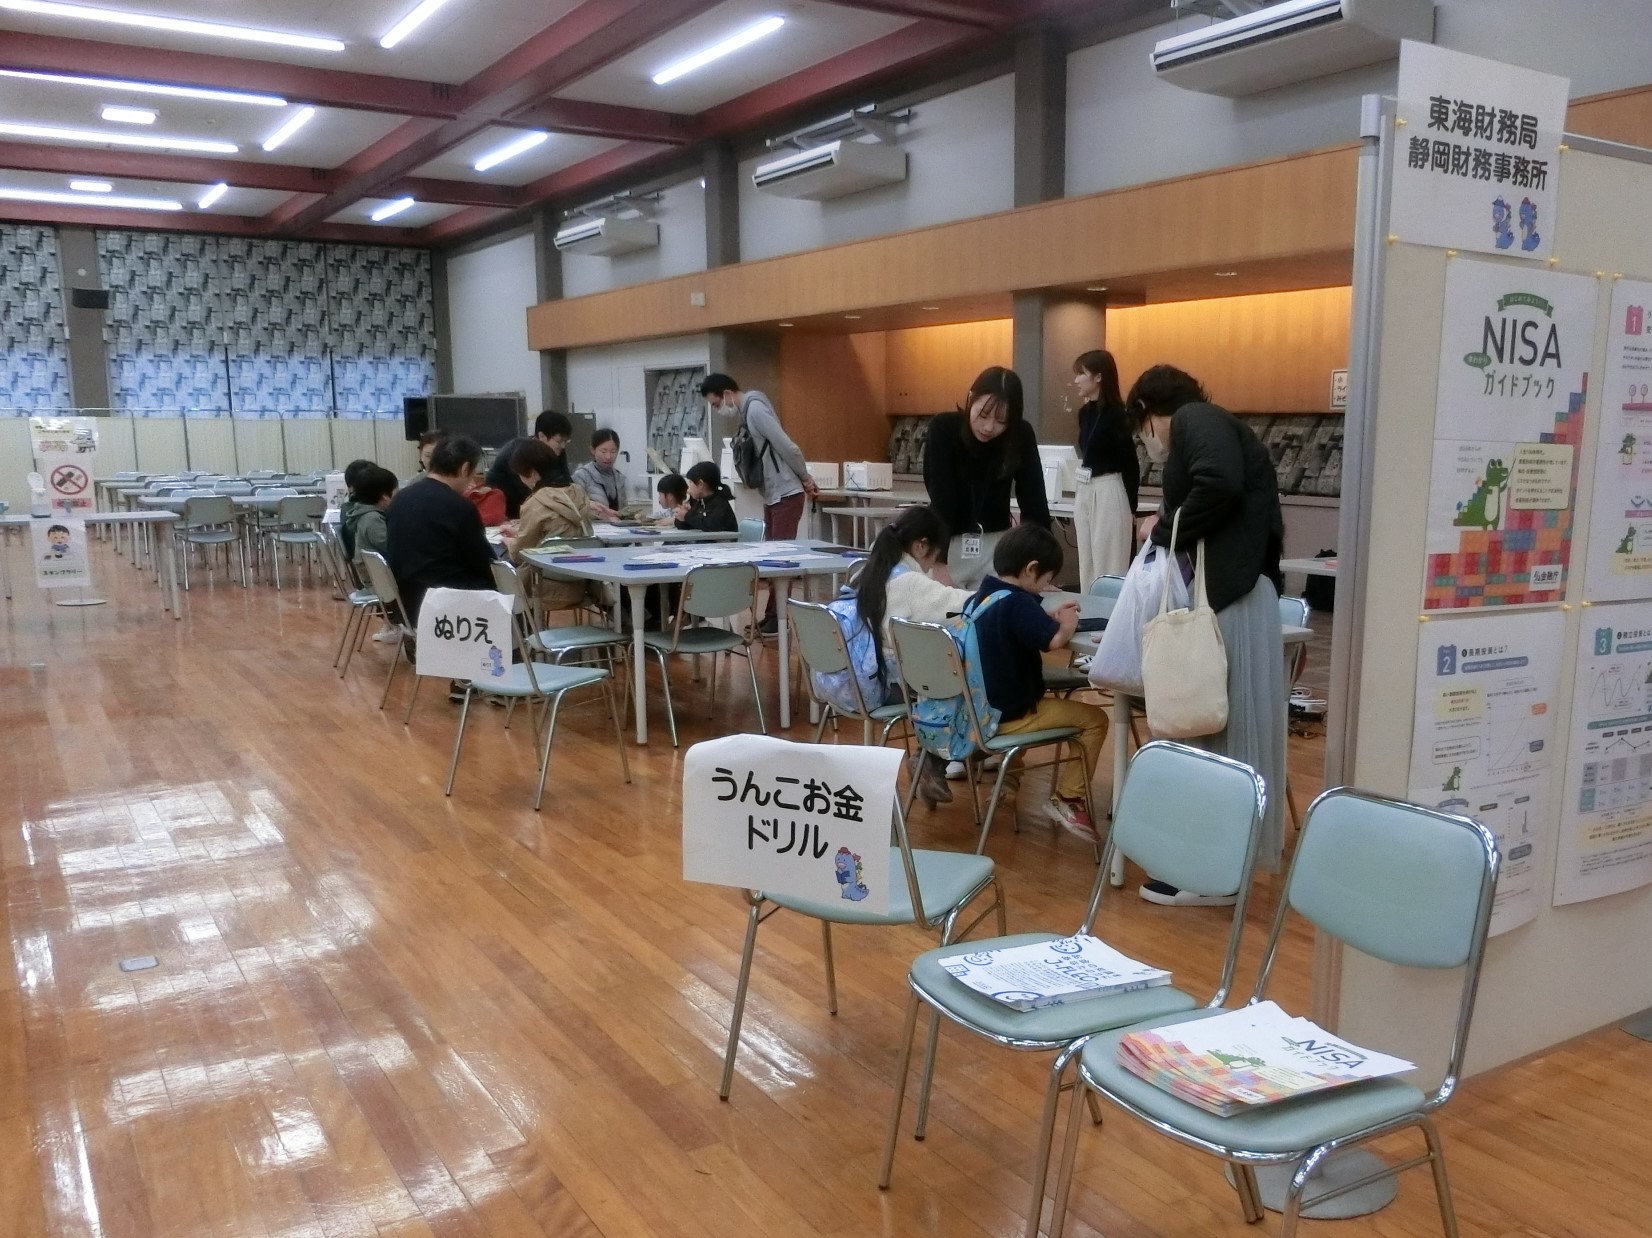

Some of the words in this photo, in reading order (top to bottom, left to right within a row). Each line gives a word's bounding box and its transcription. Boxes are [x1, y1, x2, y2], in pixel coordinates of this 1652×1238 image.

[1427, 94, 1539, 150] 東海財務局
[1408, 135, 1548, 191] 静岡財務事務所
[1482, 315, 1562, 369] NISA
[1483, 370, 1555, 399] ガイドブック
[434, 614, 493, 644] ぬりえ
[1599, 637, 1607, 654] 3
[1442, 655, 1451, 673] 2
[711, 766, 864, 823] うんこお金
[747, 814, 829, 859] ドリル
[1043, 959, 1099, 982] J-FLEC
[1296, 1039, 1365, 1069] NISA
